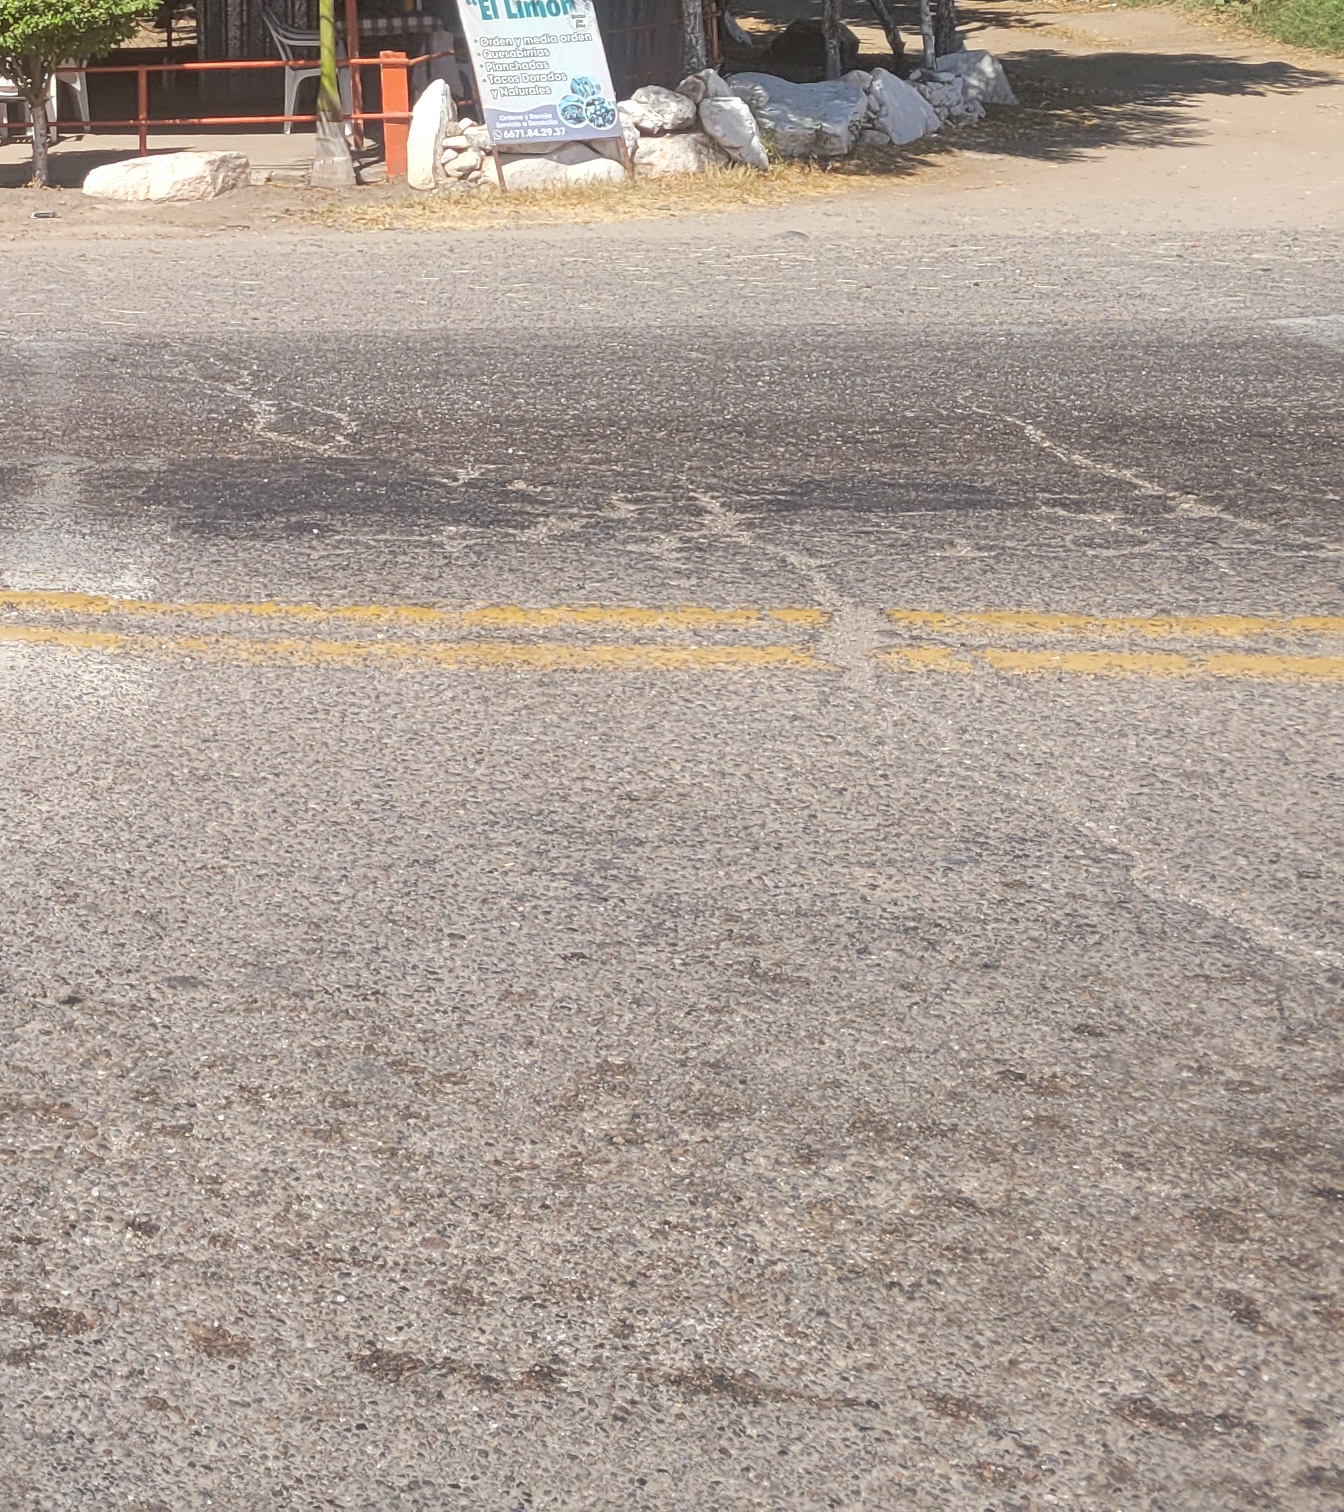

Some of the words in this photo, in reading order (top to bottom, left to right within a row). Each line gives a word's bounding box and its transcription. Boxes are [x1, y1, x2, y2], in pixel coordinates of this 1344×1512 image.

[480, 36, 513, 47] Orden
[514, 36, 521, 48] y
[523, 34, 558, 45] media
[560, 32, 592, 43] orden
[482, 48, 550, 59] Quesabirrias
[485, 60, 549, 72] Planchadas
[487, 74, 520, 85] Tacos
[521, 72, 568, 83] Dorados
[491, 88, 498, 99] y
[499, 85, 551, 97] Naturales
